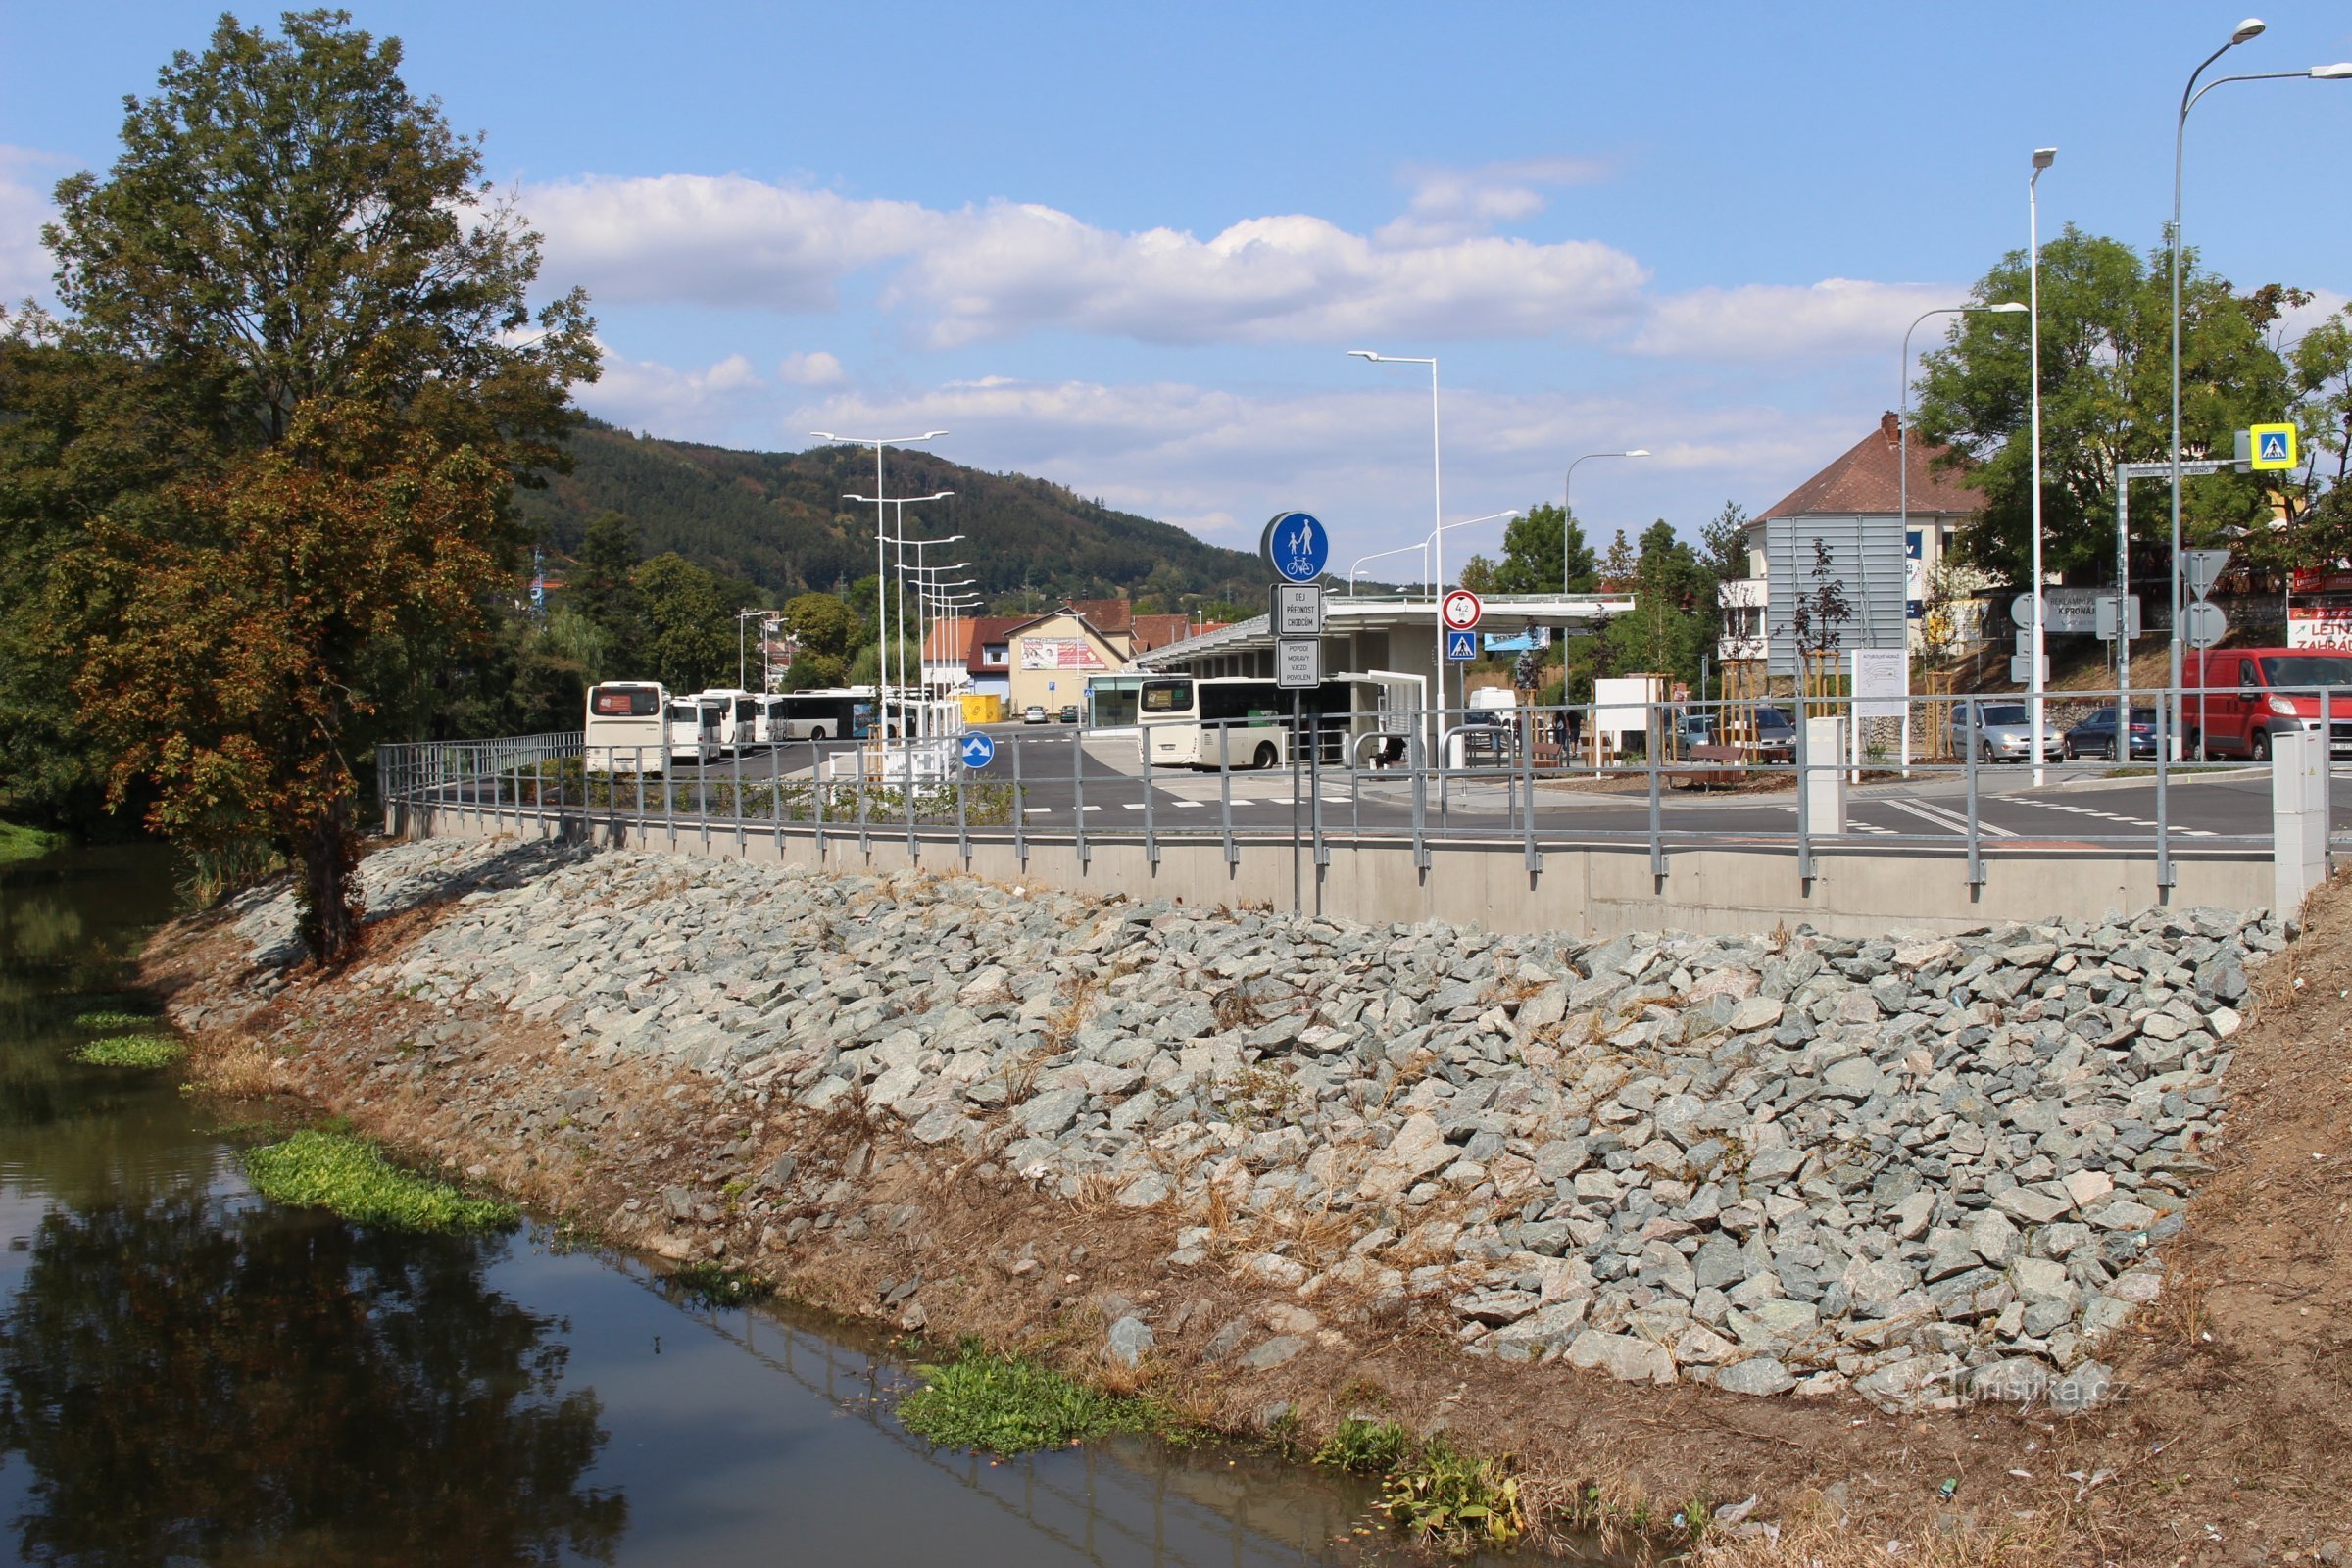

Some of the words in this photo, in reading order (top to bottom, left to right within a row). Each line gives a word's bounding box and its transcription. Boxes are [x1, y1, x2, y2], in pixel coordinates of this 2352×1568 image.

[1287, 604, 1314, 613] PŘEDNOST
[1455, 603, 1469, 612] 4,2
[2312, 623, 2352, 635] LETN
